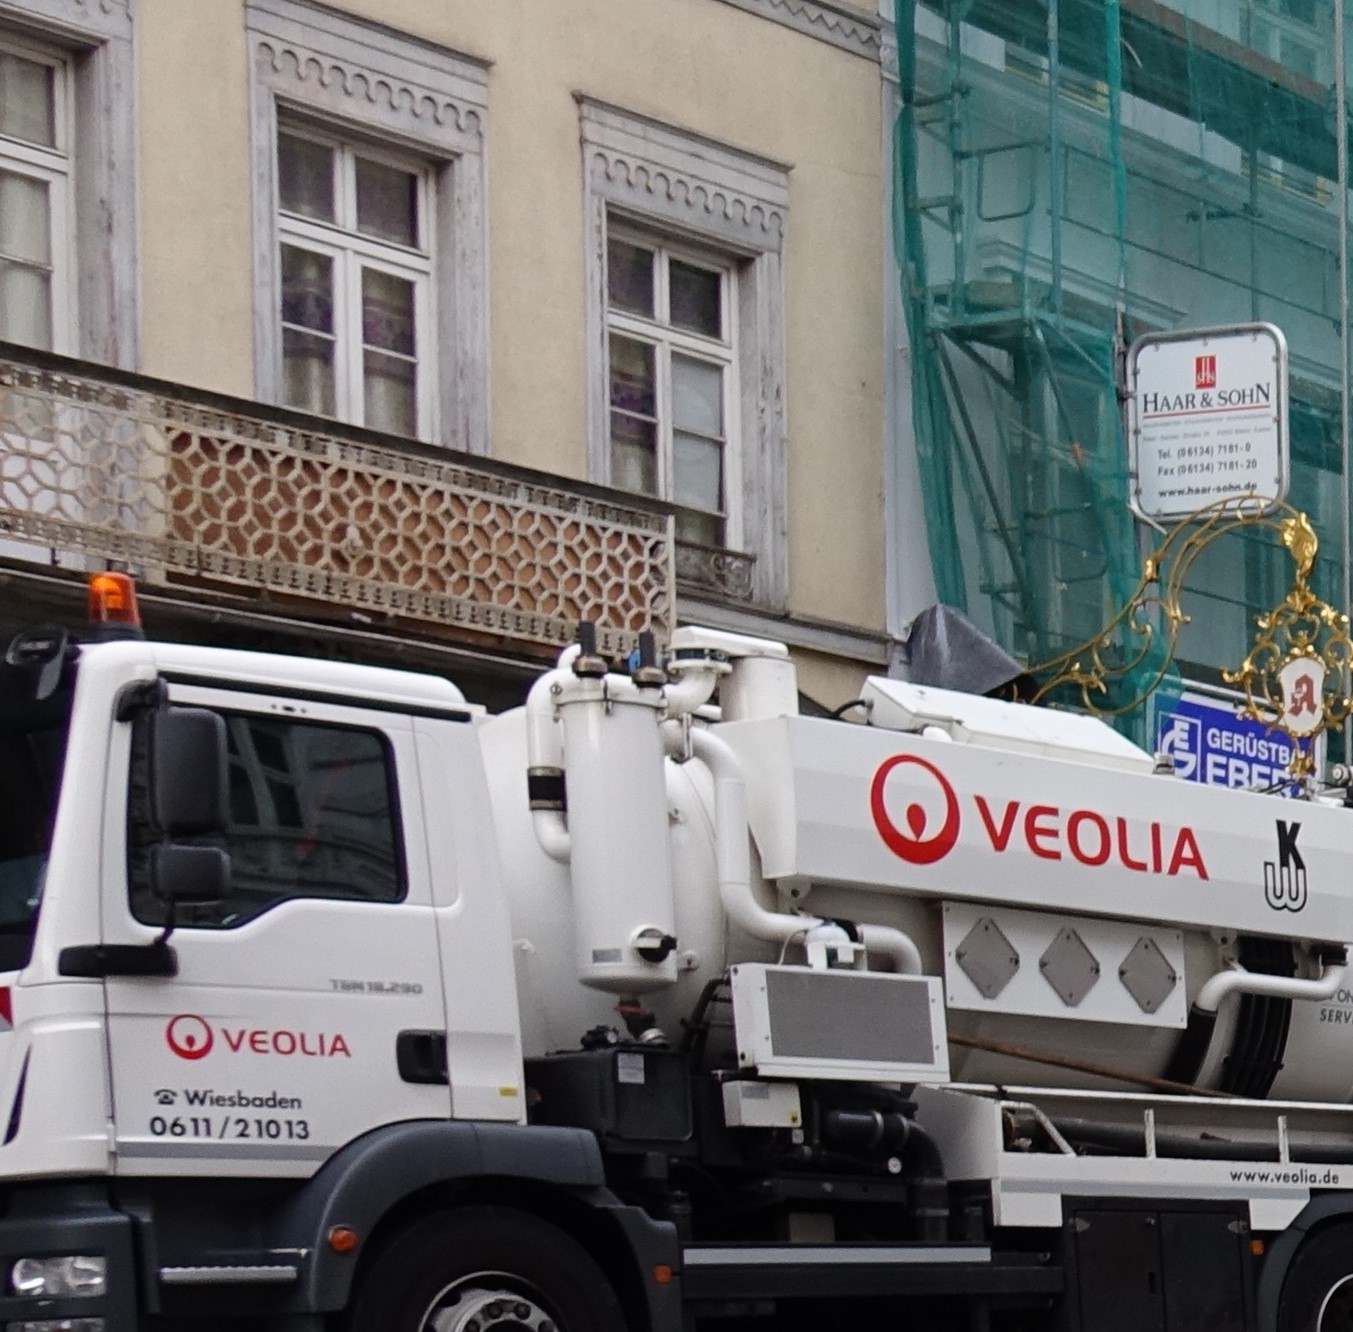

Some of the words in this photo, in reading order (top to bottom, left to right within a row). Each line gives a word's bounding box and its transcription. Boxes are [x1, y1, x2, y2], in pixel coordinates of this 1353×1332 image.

[1142, 391, 1196, 414] HAAR
[1200, 392, 1215, 409] &
[1217, 382, 1271, 406] SOHN
[1206, 727, 1298, 766] GERÜSTB
[974, 795, 1209, 880] VEOLIA
[221, 1027, 351, 1058] VEOLIA
[184, 1089, 302, 1109] Wiesbaden
[1230, 1168, 1339, 1185] www.veolia.de
